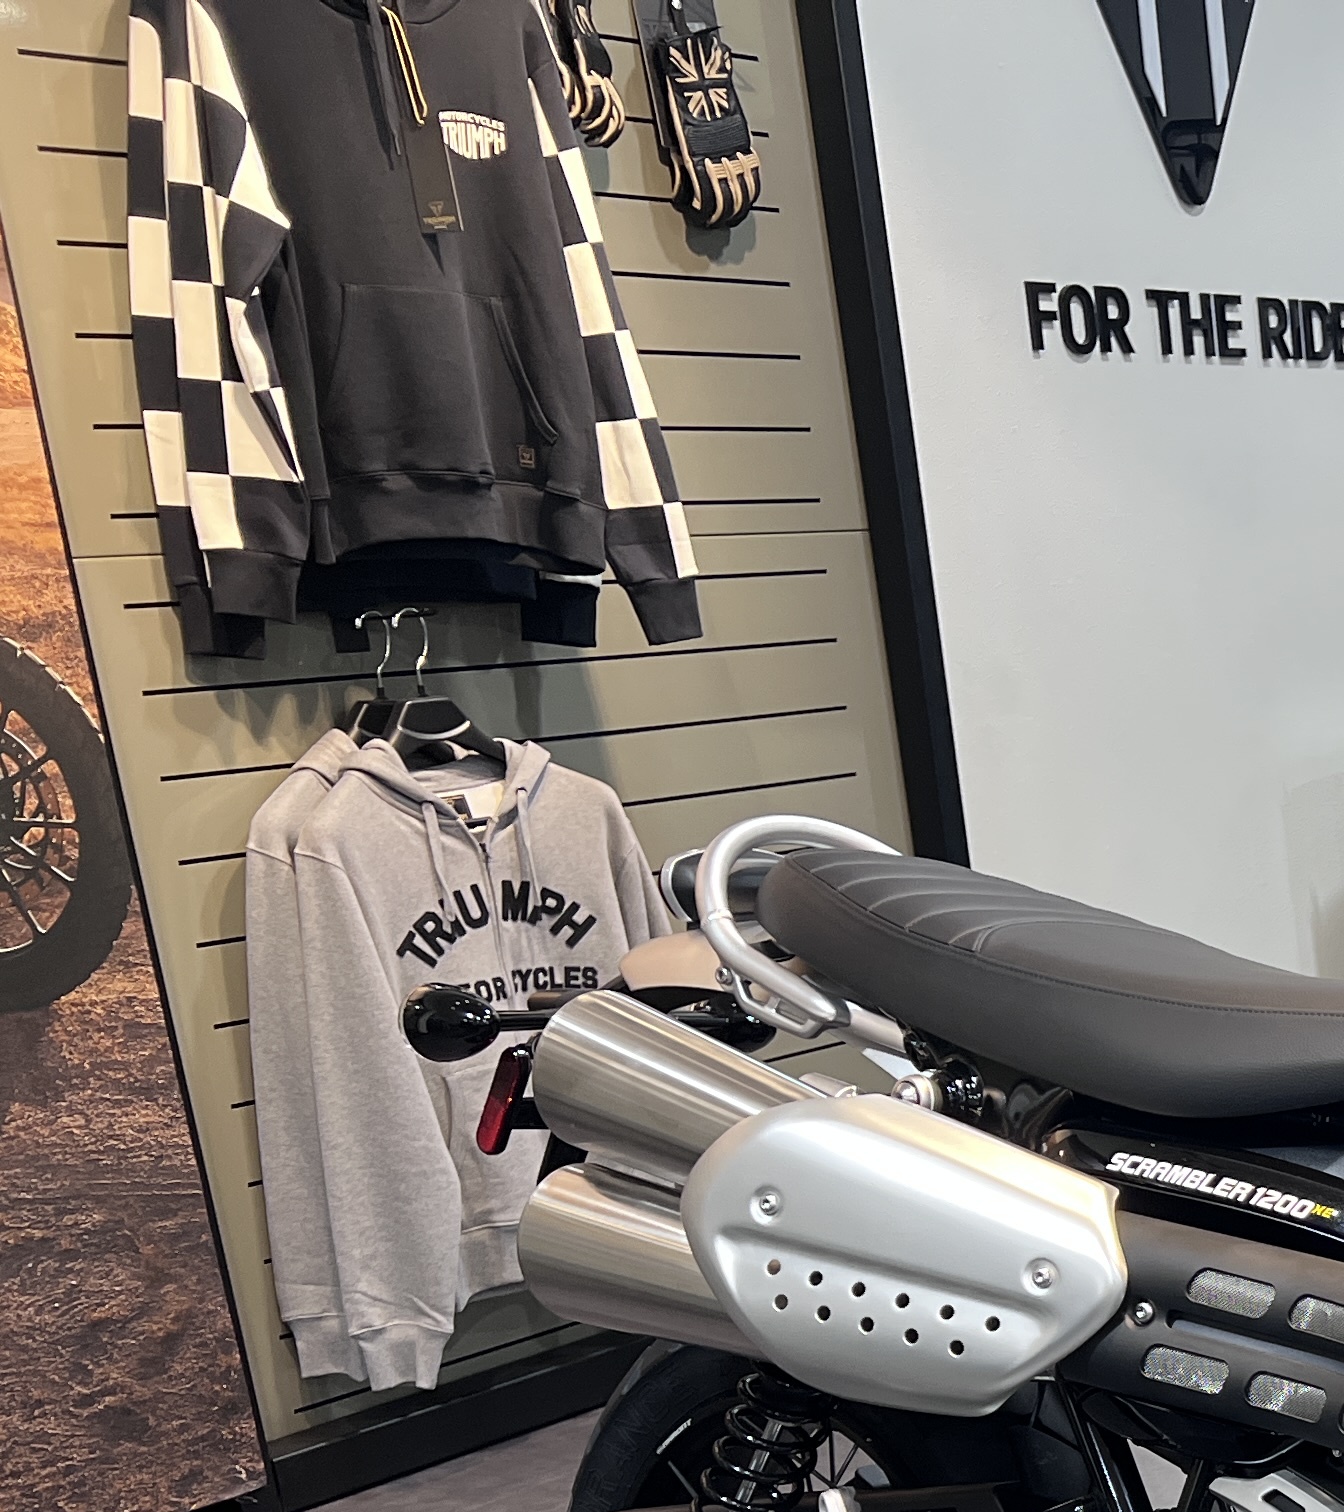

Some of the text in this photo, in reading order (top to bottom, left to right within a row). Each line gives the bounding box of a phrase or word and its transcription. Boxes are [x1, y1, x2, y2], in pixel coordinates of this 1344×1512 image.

[441, 121, 507, 159] TRIUMPH
[1024, 280, 1134, 356] FOR
[1146, 288, 1247, 360] THE
[1105, 1152, 1254, 1203] SCRAMBLER
[1249, 1187, 1316, 1219] 1200
